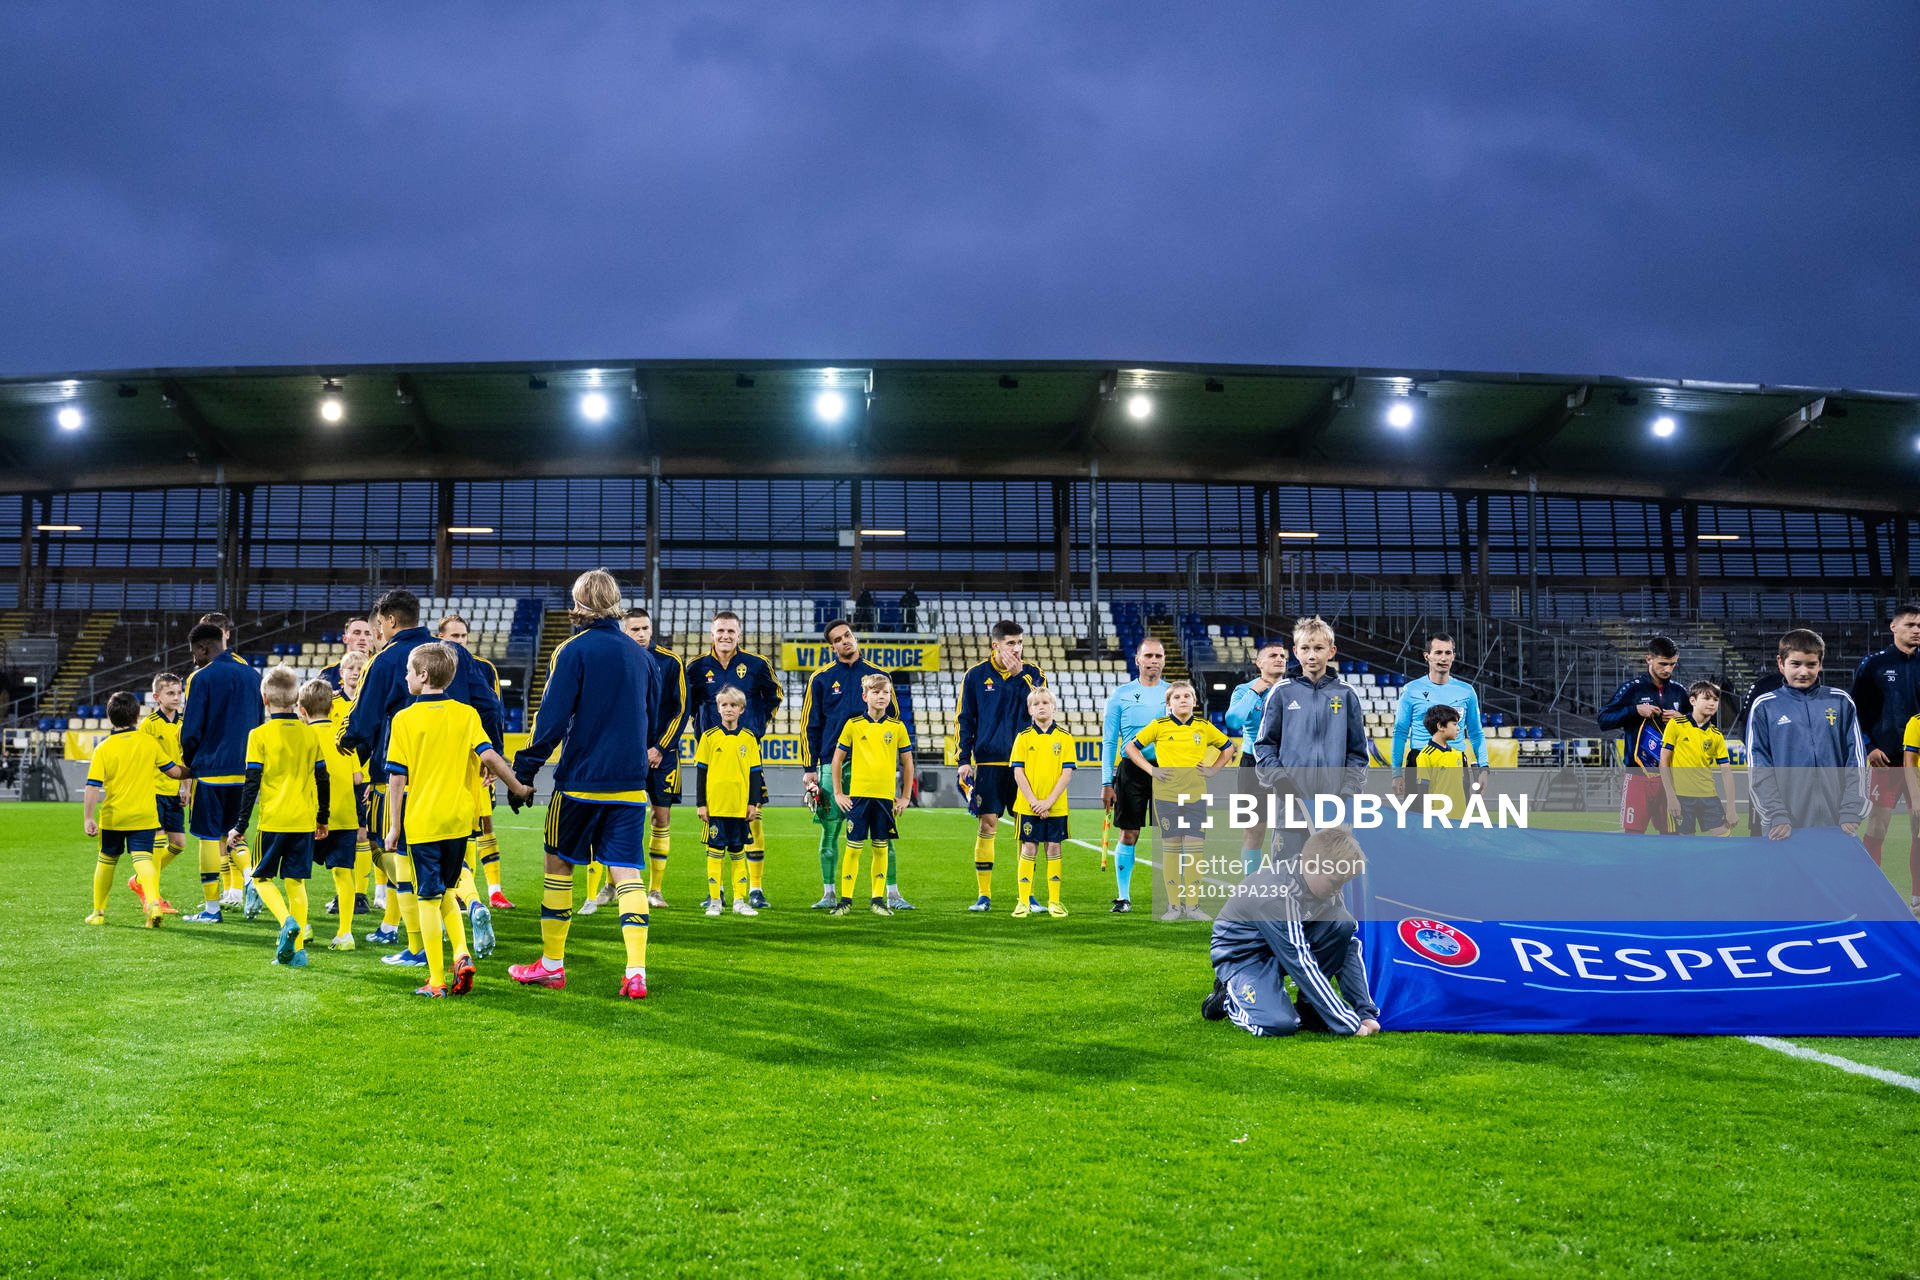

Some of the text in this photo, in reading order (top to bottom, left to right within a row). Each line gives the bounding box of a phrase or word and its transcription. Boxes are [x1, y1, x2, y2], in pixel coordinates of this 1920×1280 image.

[796, 647, 814, 666] VI
[860, 647, 923, 667] VERIGE
[761, 739, 798, 759] IGE!
[665, 769, 676, 786] 4
[1871, 784, 1880, 801] 4
[1626, 807, 1635, 824] 6
[1409, 920, 1456, 937] UEFA
[1510, 931, 1868, 982] RESPECT
